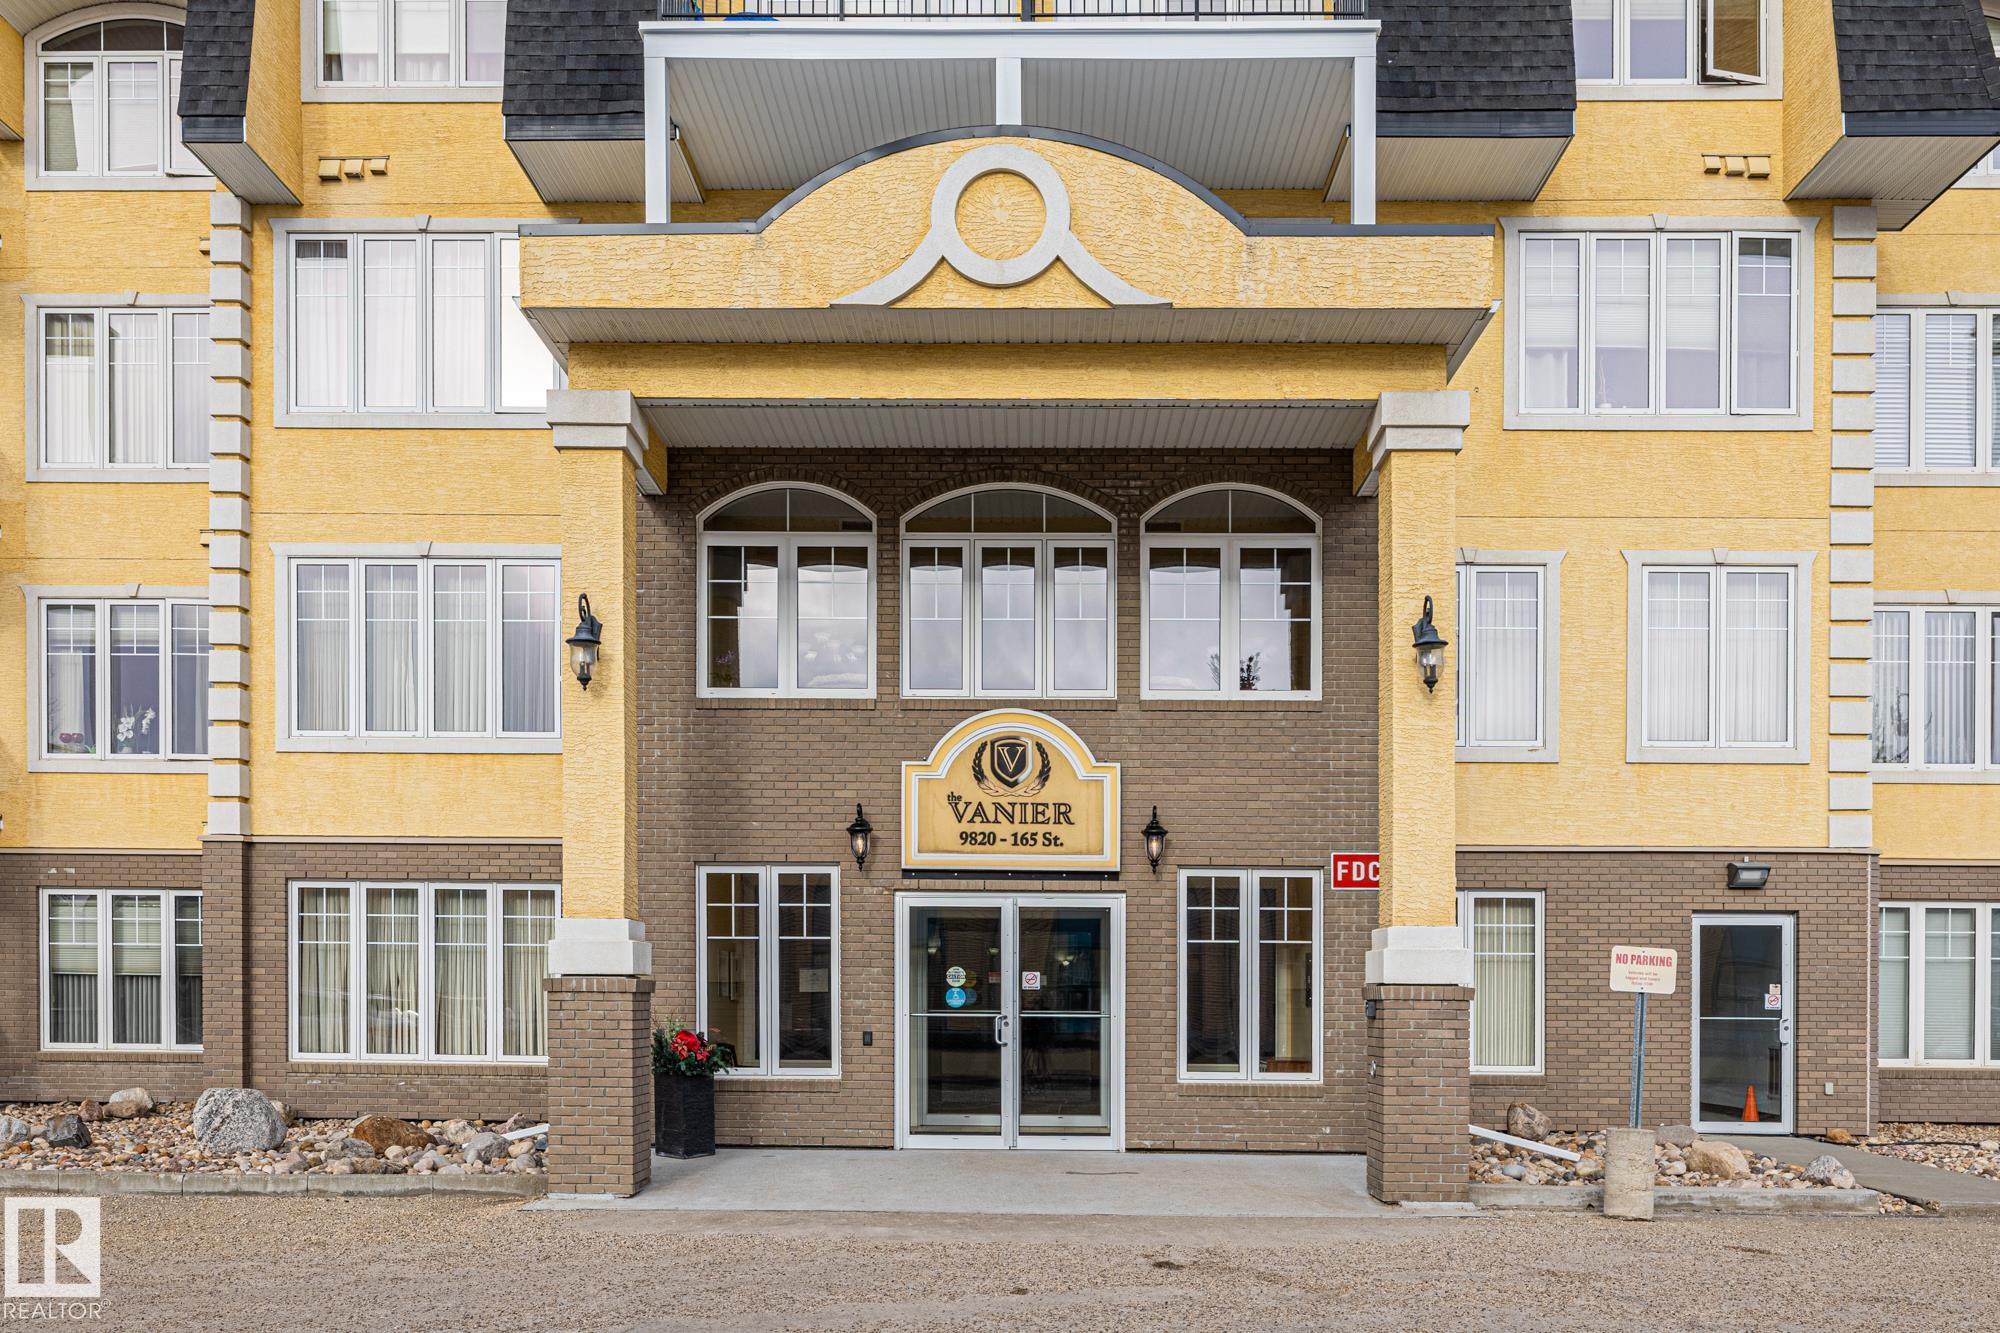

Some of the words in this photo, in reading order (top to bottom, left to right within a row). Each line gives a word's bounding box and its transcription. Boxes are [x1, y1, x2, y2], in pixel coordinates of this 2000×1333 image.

[997, 746, 1025, 773] V
[947, 791, 963, 802] the
[948, 801, 1075, 825] VANIER
[959, 831, 997, 846] 9820
[1011, 832, 1037, 847] 165
[1042, 831, 1064, 847] St.
[1337, 861, 1380, 881] FDC
[1615, 953, 1628, 964] NO
[1630, 954, 1673, 967] PARKING
